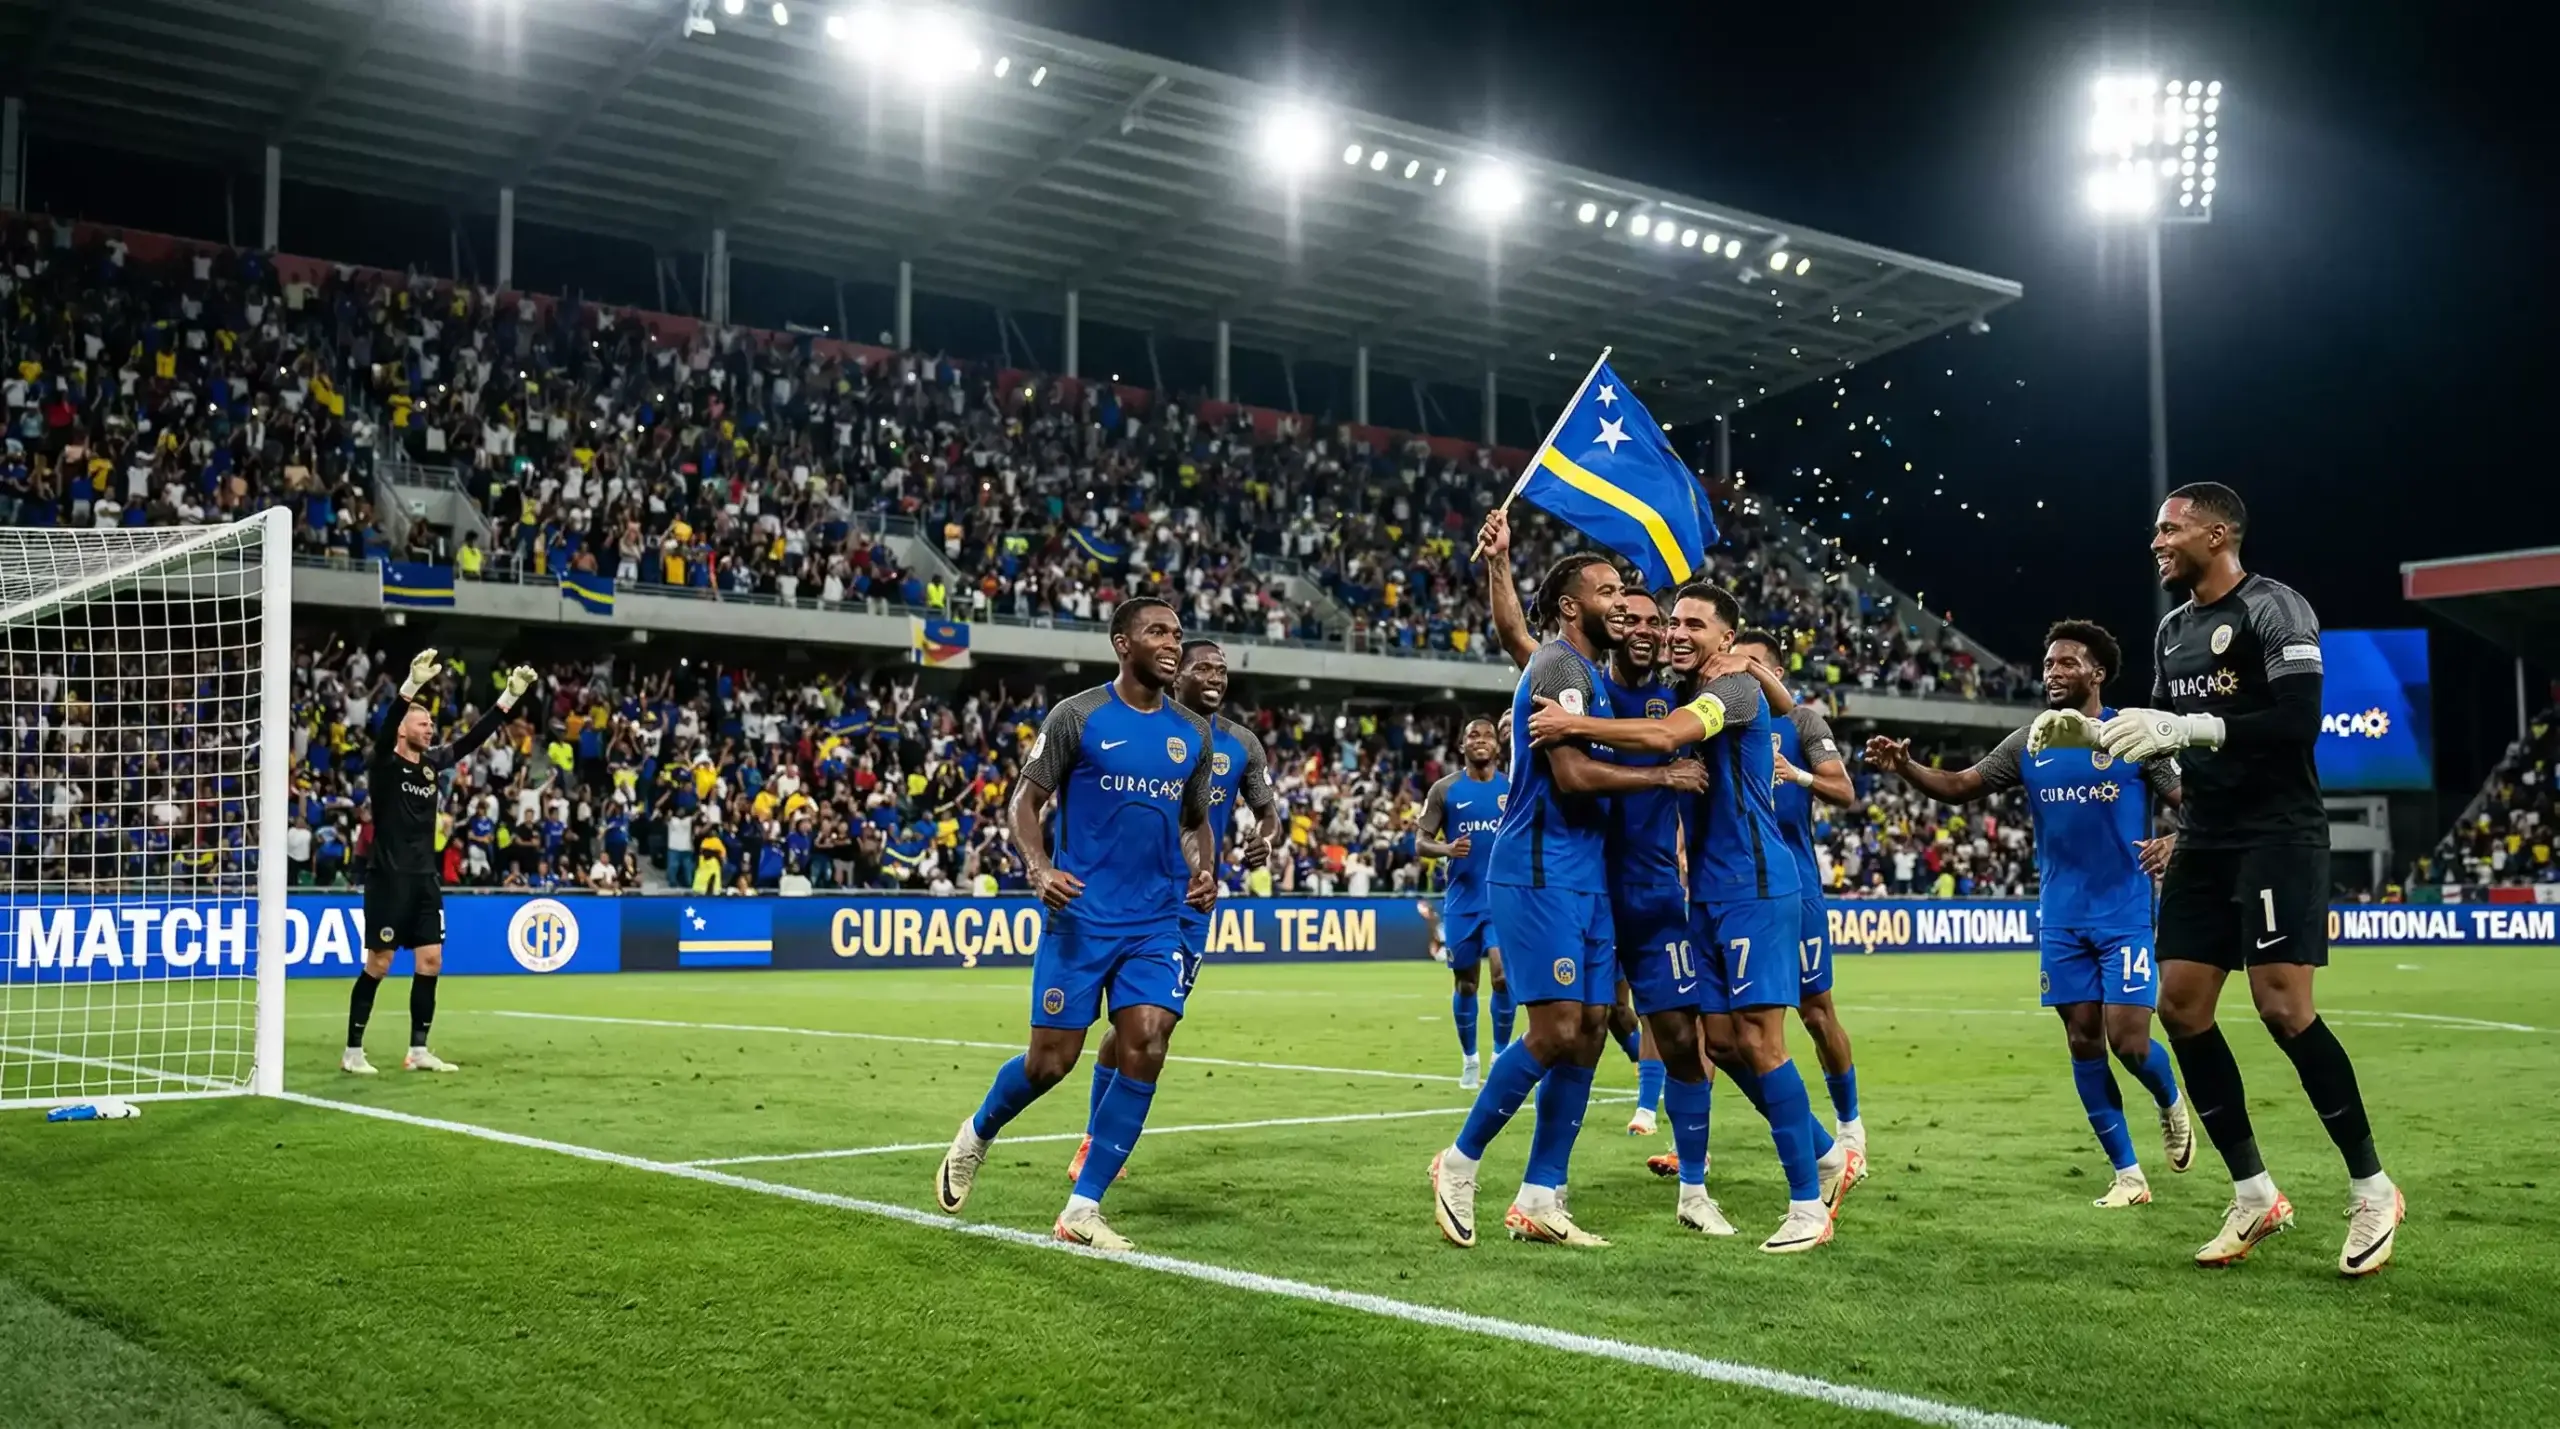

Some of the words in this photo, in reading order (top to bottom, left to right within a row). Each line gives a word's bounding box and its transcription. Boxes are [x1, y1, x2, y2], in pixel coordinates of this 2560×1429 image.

[2321, 707, 2391, 739] AÇAO
[2260, 888, 2277, 932] 1
[2343, 910, 2466, 940] NATIONAL
[2471, 910, 2556, 940] TEAM
[16, 908, 247, 968] MATCH
[831, 908, 1042, 967] CURAÇAO
[1275, 909, 1377, 952] TEAM
[1827, 909, 1911, 954] RAÇAO
[1916, 909, 2034, 944] NATIONAL
[1666, 940, 1696, 980] 10
[1731, 937, 1750, 979] 7
[1799, 936, 1822, 972] 17
[2120, 946, 2151, 982] 14
